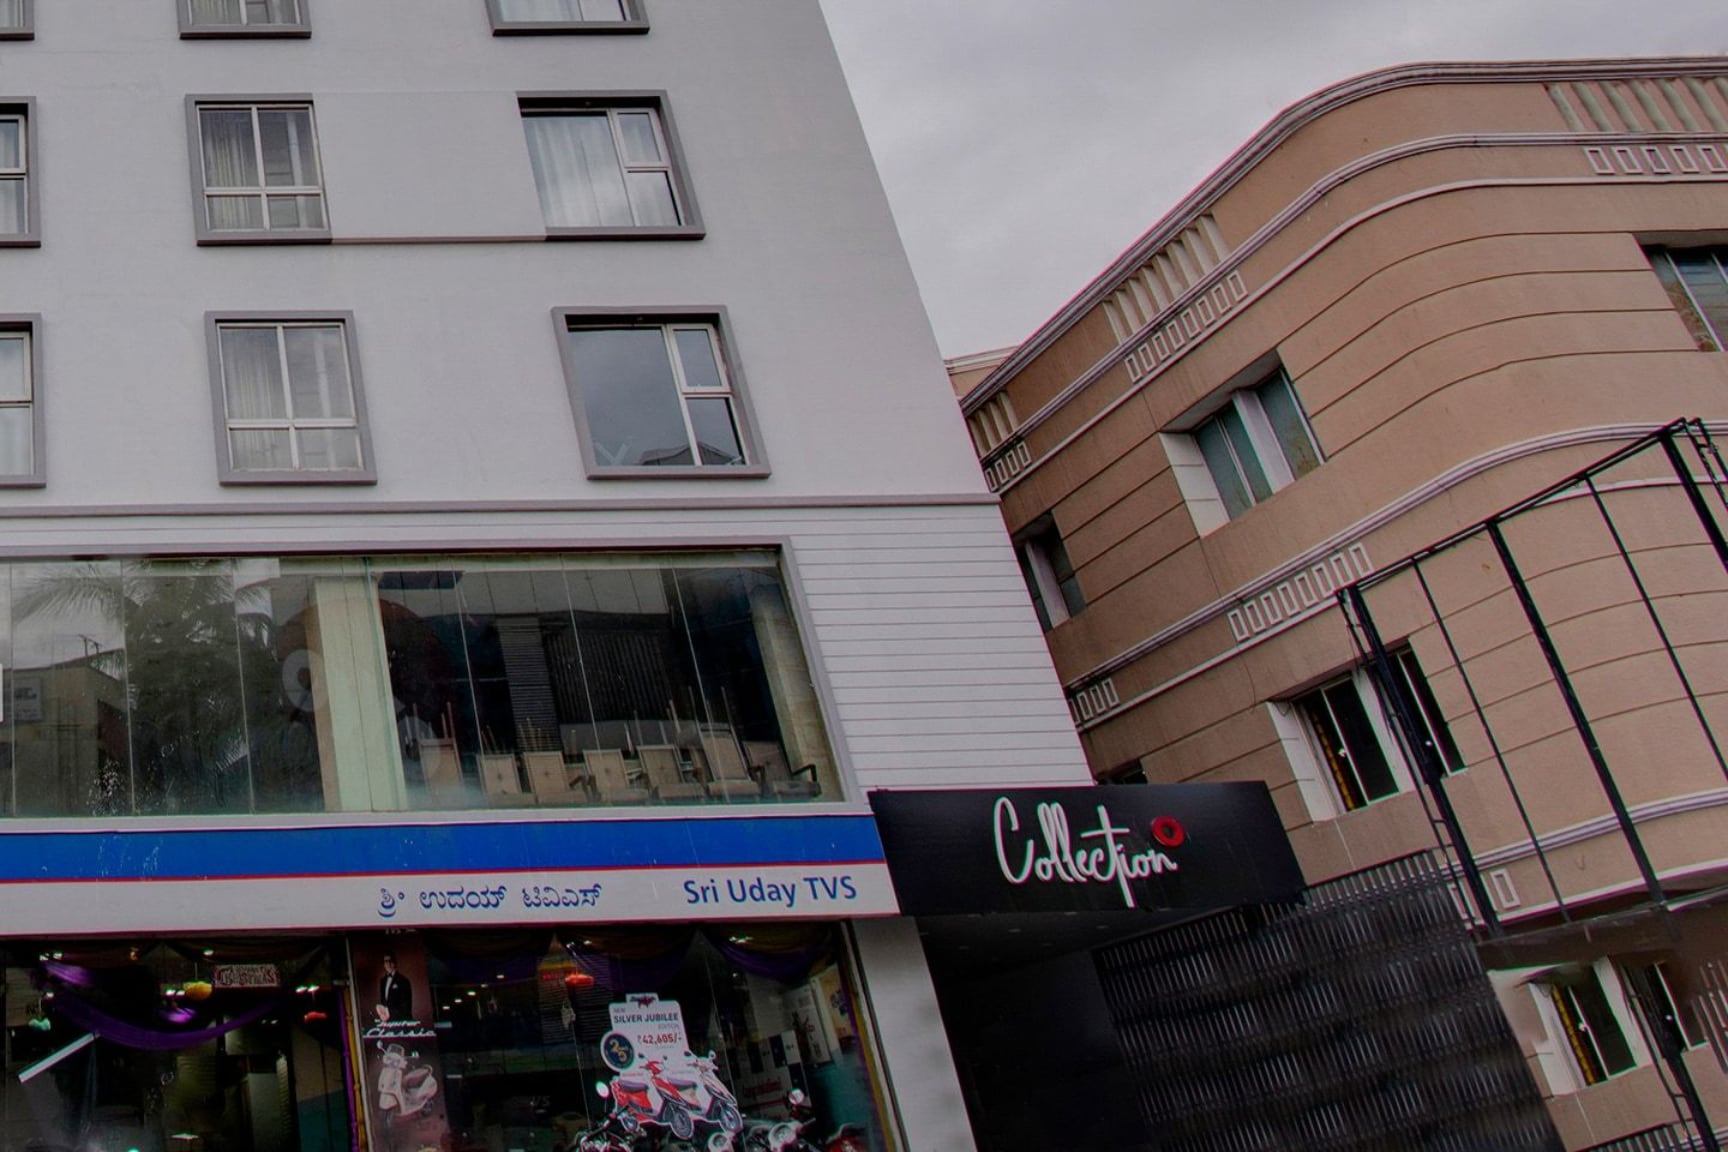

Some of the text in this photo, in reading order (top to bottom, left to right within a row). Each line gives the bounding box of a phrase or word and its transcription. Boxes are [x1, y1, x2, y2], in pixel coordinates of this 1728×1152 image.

[993, 796, 1178, 908] Collection
[683, 875, 858, 908] Sri Uday TVS
[613, 1012, 679, 1023] SILVER JUBILEE
